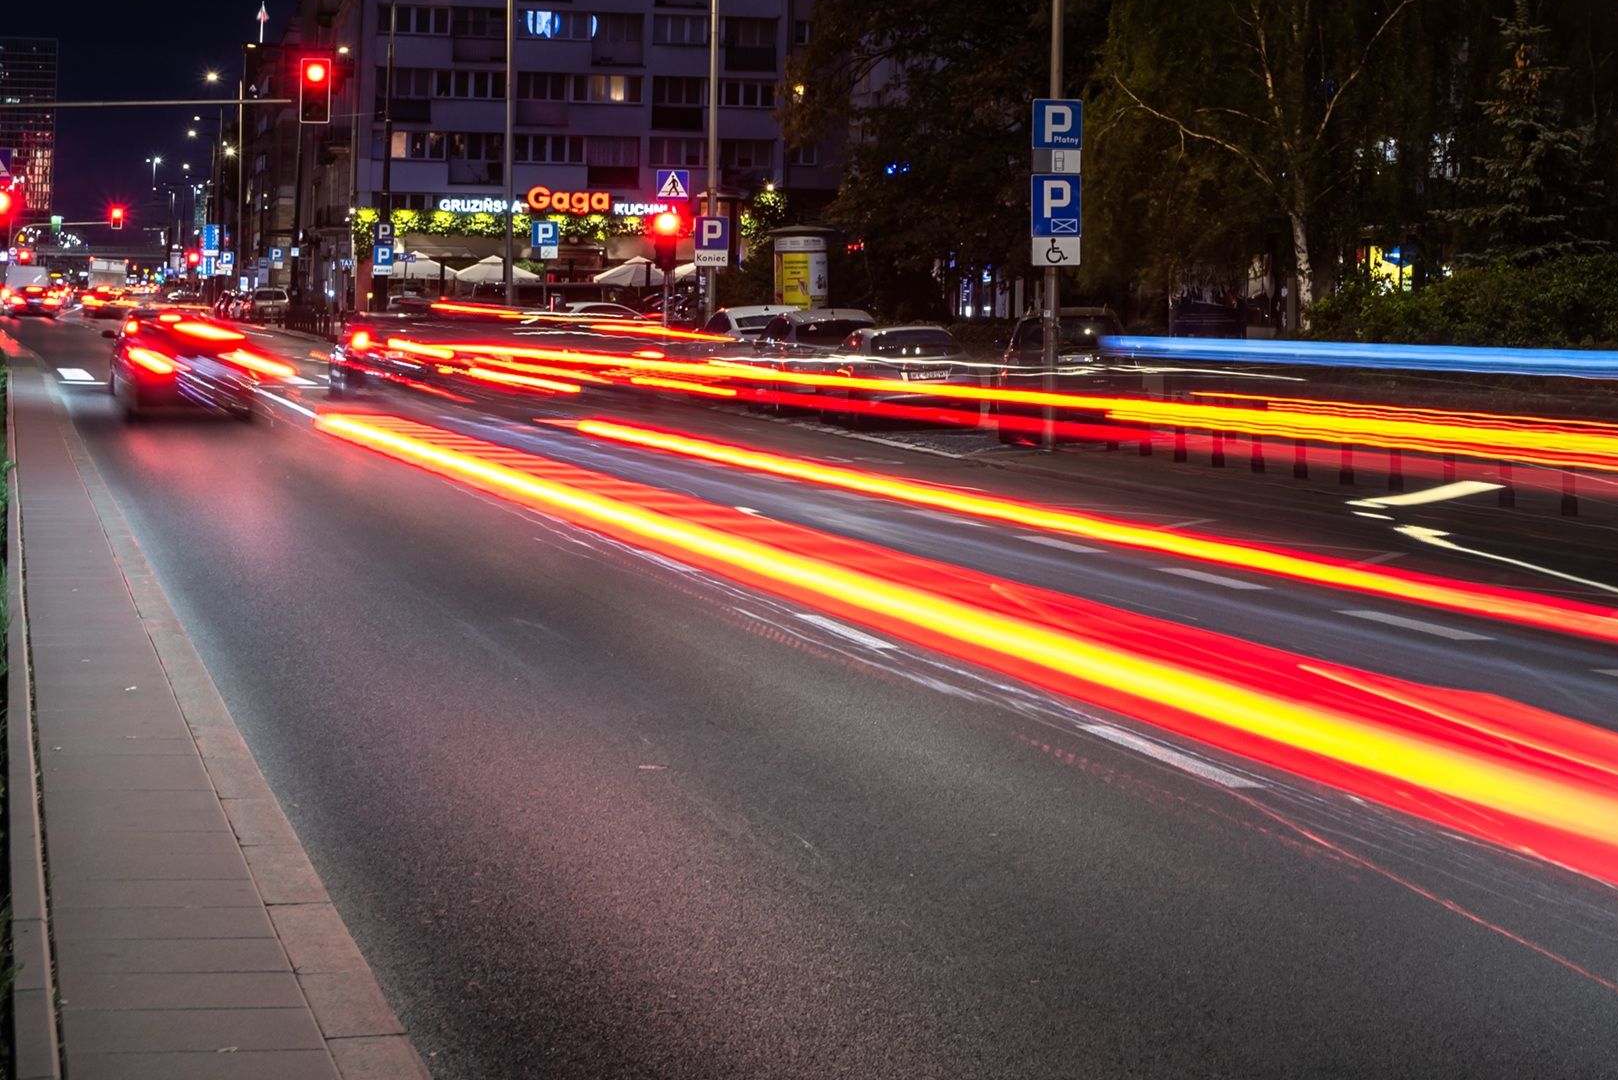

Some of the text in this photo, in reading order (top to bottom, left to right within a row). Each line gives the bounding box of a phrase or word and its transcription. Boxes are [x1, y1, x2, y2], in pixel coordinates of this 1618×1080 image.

[1044, 105, 1072, 143] P
[1053, 135, 1079, 145] Płatny
[527, 186, 610, 215] Gaga
[614, 203, 677, 215] KUCHNI
[1043, 180, 1071, 218] P
[538, 223, 553, 244] P
[702, 220, 722, 246] P
[272, 249, 282, 261] P
[378, 248, 390, 263] P
[696, 254, 726, 263] Koniec
